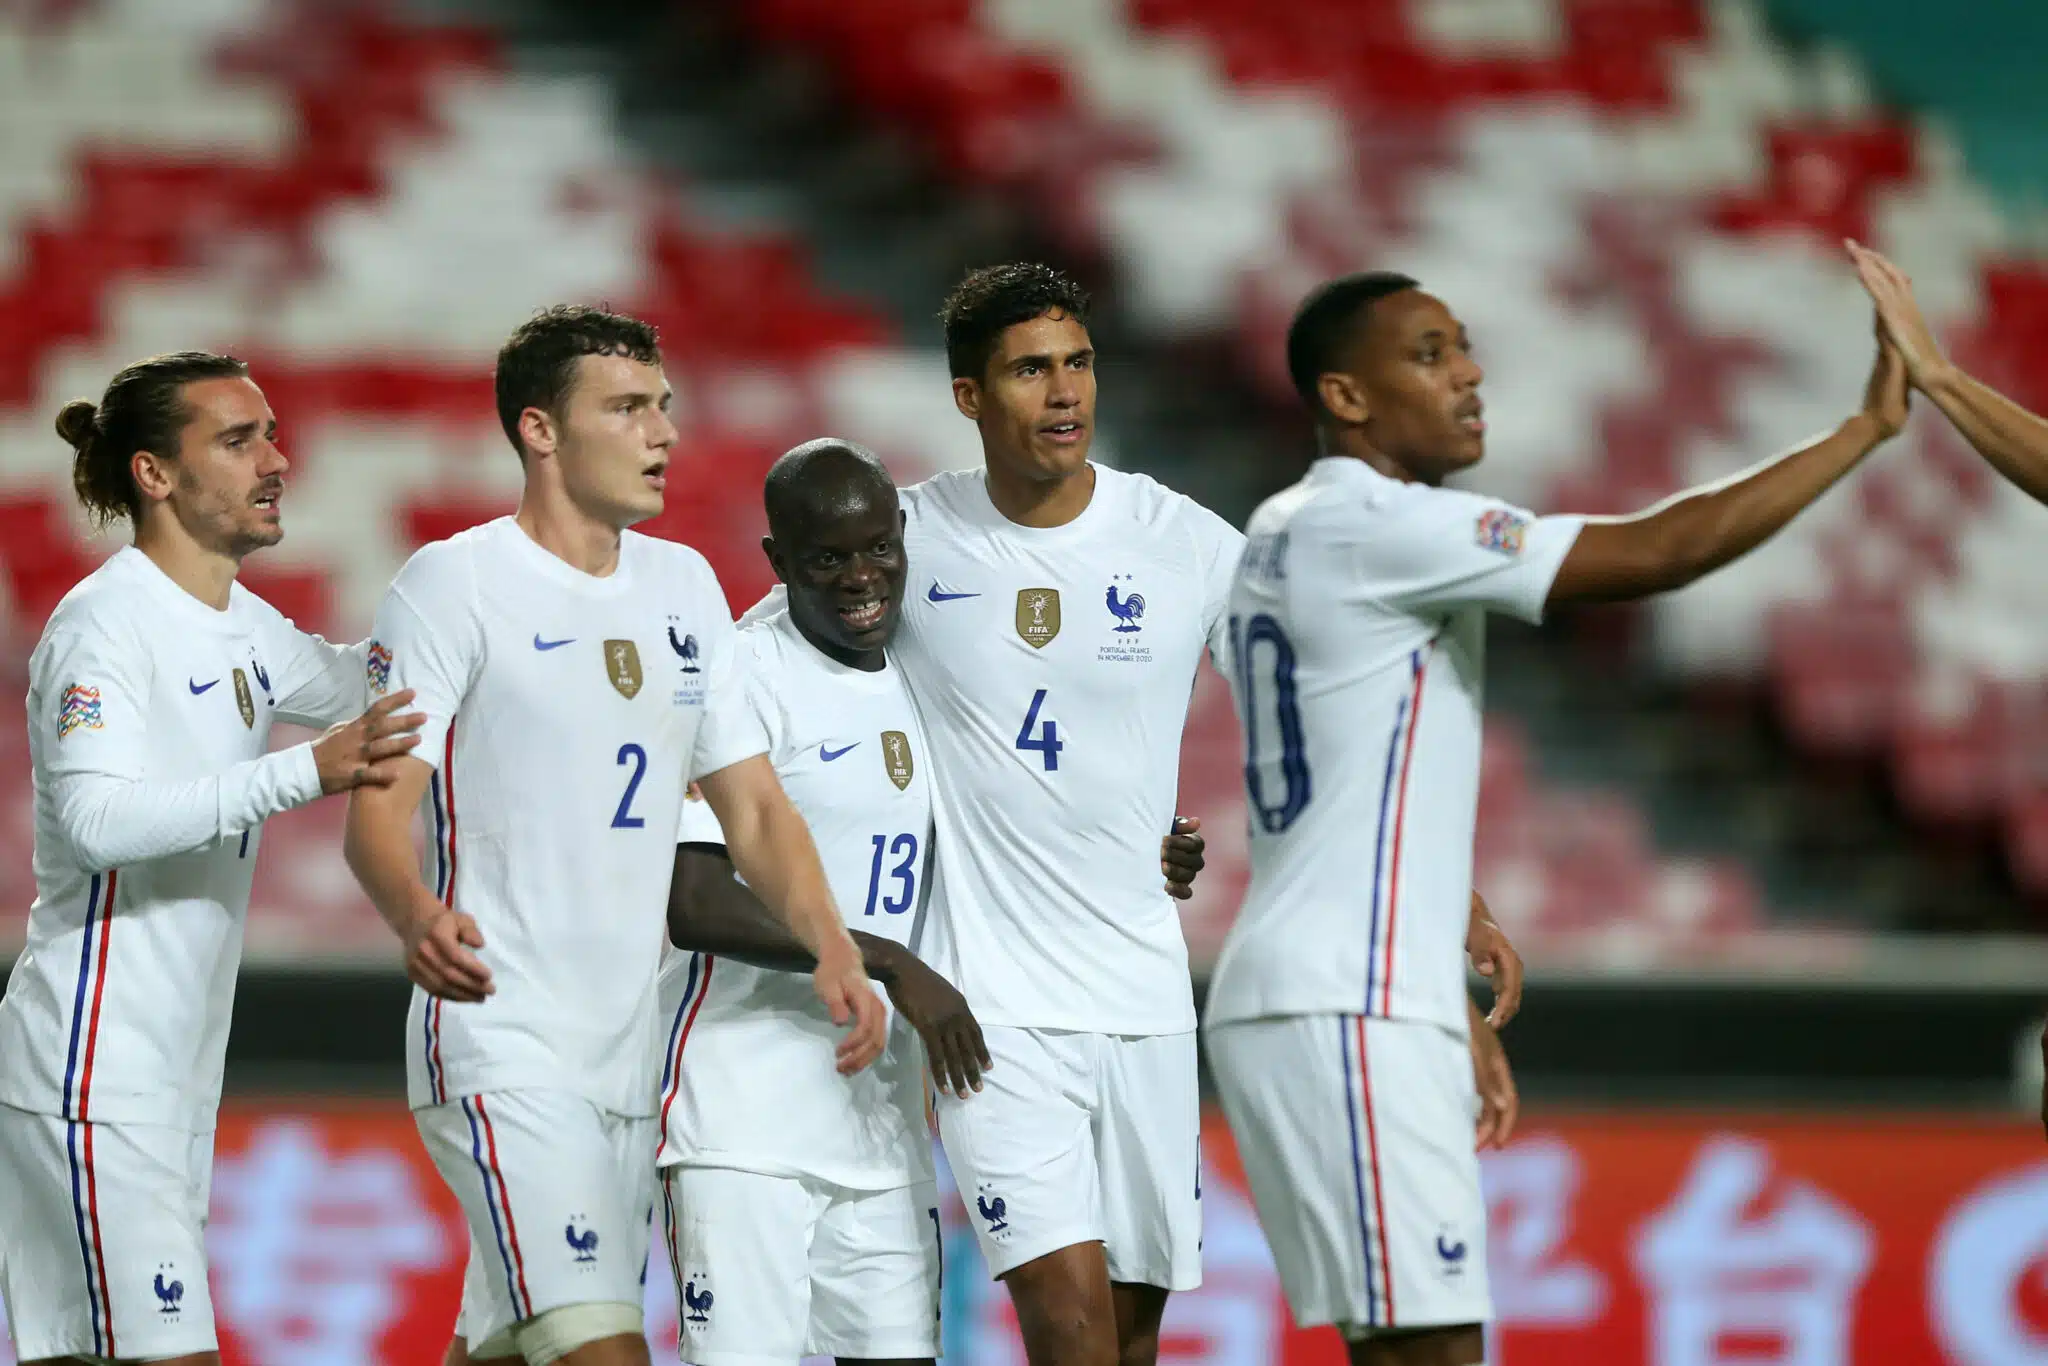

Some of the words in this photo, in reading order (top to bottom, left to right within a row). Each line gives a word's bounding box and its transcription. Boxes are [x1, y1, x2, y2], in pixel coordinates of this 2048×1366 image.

[1028, 626, 1048, 634] FIFA
[1105, 654, 1134, 662] NOVEMBRE
[1136, 655, 1153, 663] 2020
[1016, 688, 1063, 771] 4
[611, 743, 648, 829] 2
[864, 832, 919, 916] 13
